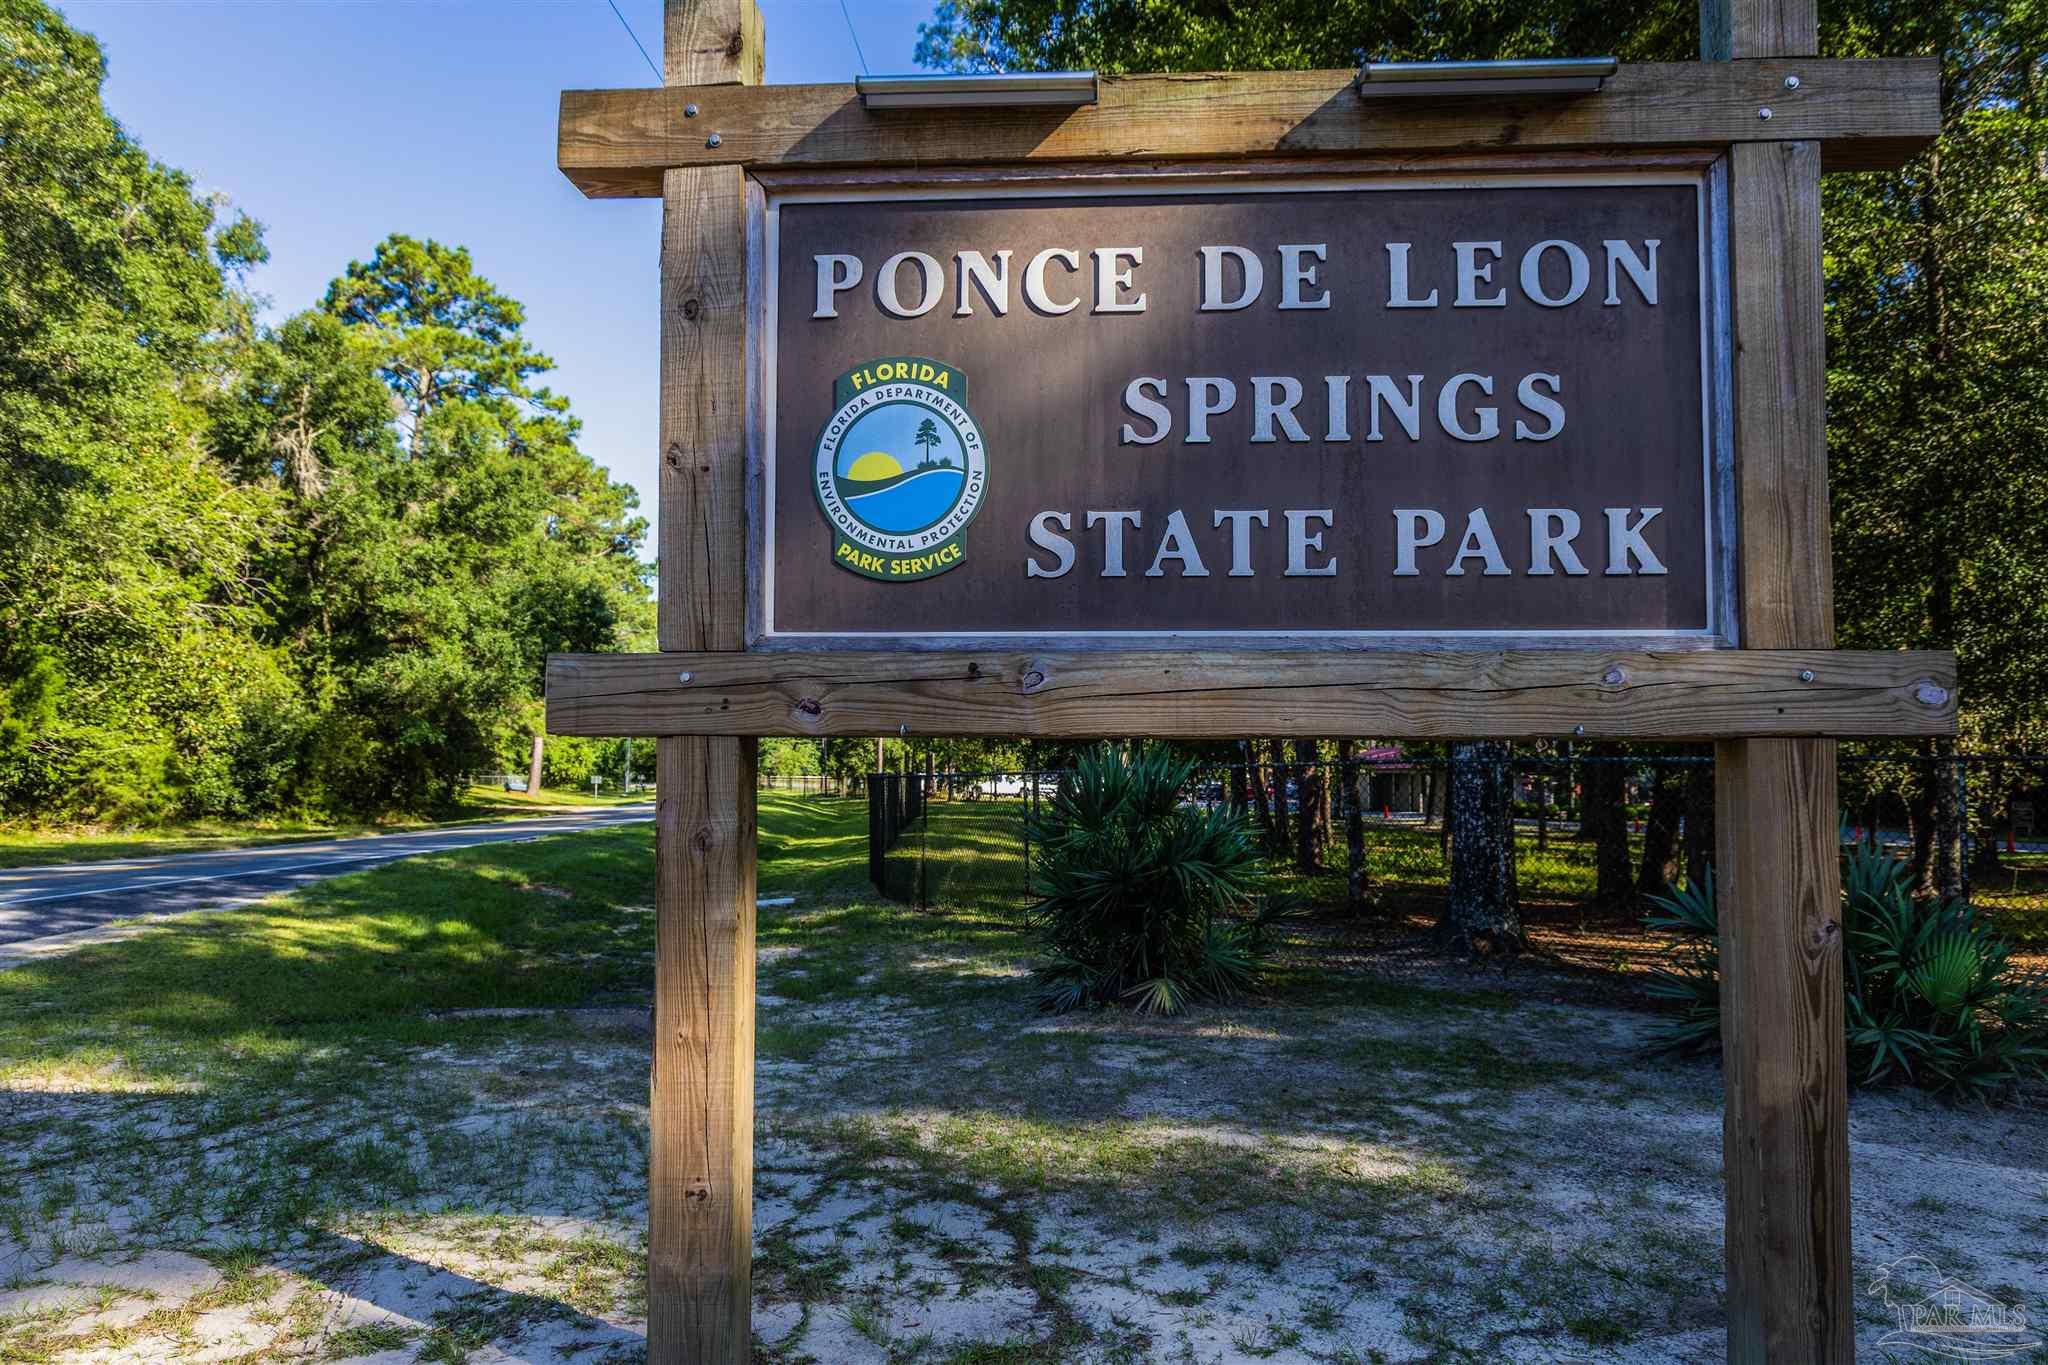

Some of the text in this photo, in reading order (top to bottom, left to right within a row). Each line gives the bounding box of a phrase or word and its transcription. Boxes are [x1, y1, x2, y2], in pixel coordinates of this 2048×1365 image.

[812, 239, 1661, 318] PONCE DE LEON
[851, 362, 949, 390] FLORIDA
[1123, 375, 1566, 443] SPRINGS
[824, 387, 979, 451] FLORIDA DEPARTMENT OF
[819, 470, 983, 549] ENVIRONMENTAL PROTECTION
[1026, 507, 1668, 579] STATE PARK
[837, 543, 962, 575] PARK SERVICE
